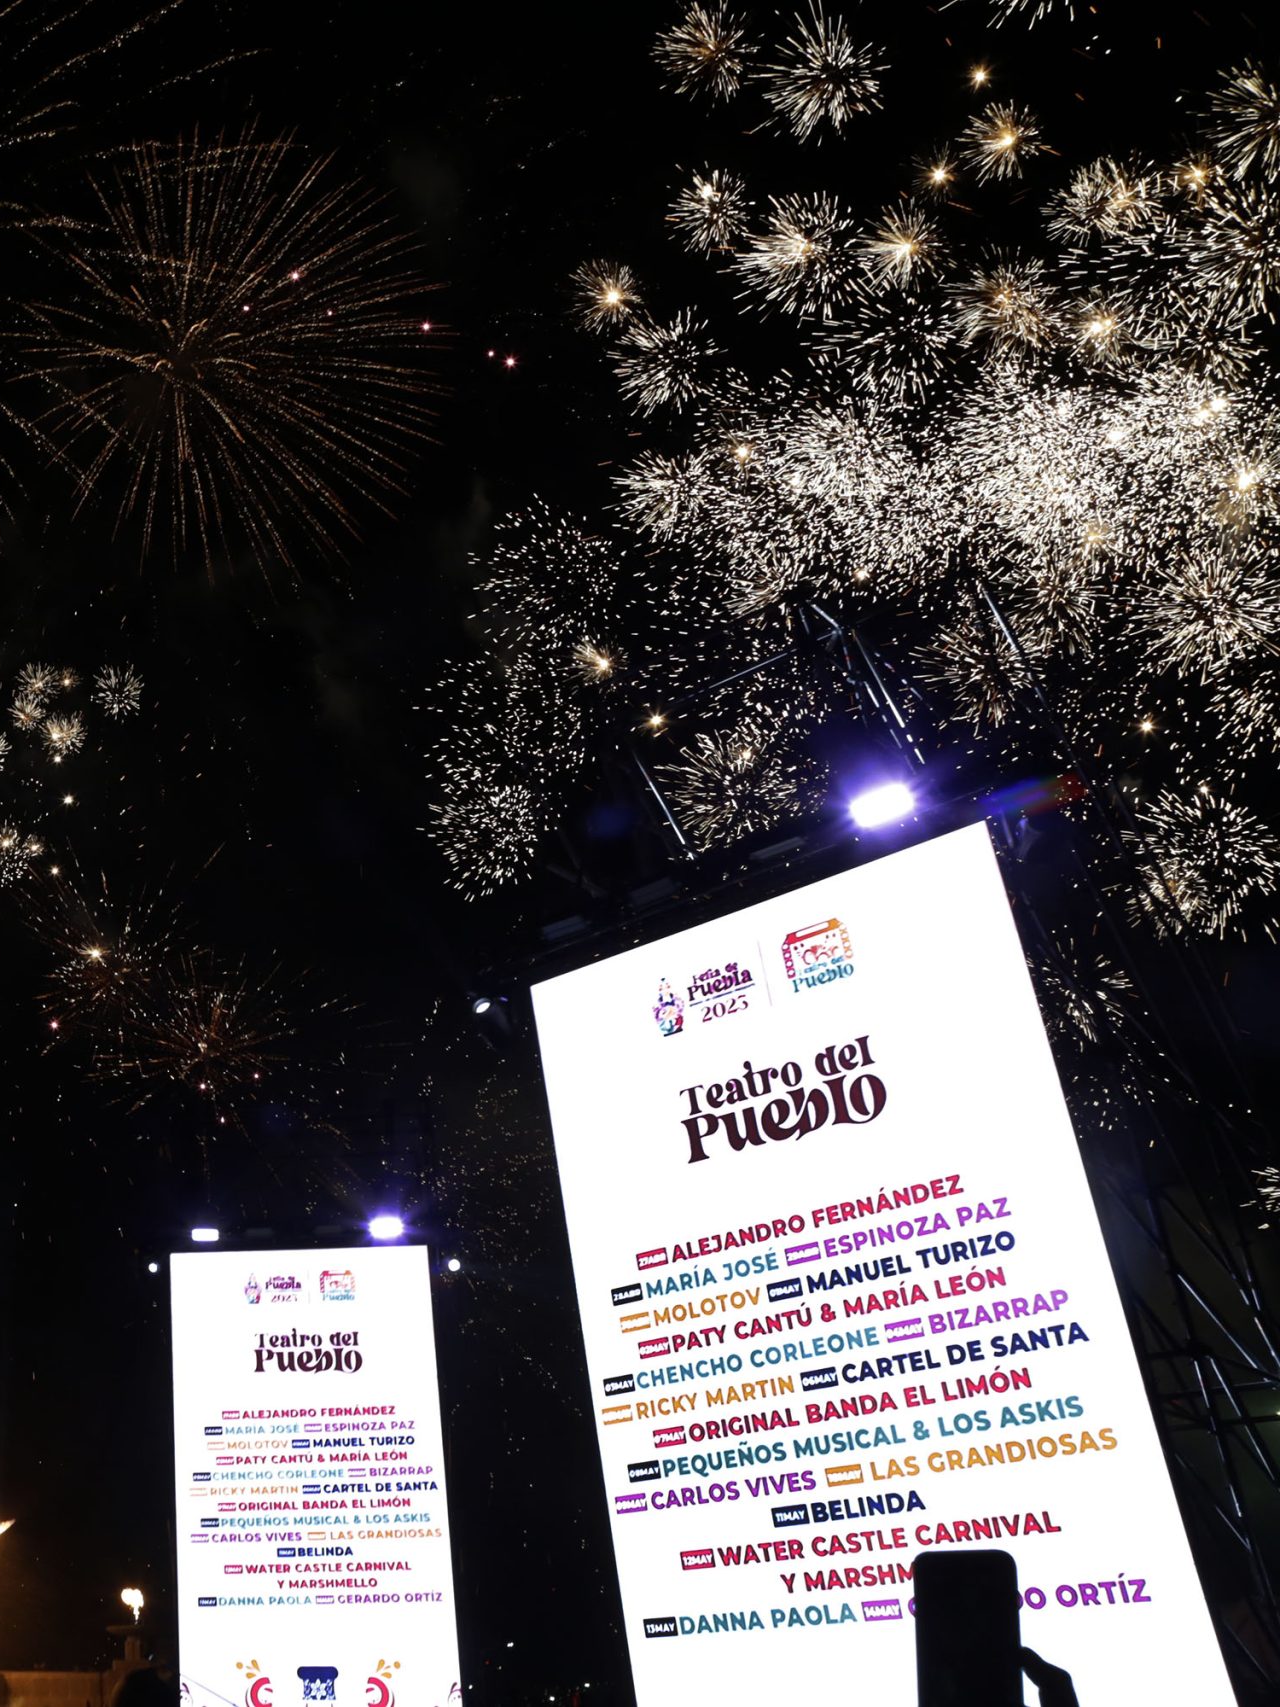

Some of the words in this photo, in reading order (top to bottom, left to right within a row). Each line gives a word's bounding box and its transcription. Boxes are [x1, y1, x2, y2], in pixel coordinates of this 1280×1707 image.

[686, 968, 753, 1001] Puebla
[791, 963, 854, 993] Pueblo
[679, 1060, 802, 1116] Teatro
[814, 1034, 875, 1076] del
[680, 1073, 887, 1164] Pueblo
[671, 1214, 805, 1263] ALEJANDRO
[811, 1173, 964, 1228] FERNÁNDEZ
[645, 1264, 717, 1298] MARÍA
[722, 1246, 779, 1281] JOSÉ
[823, 1212, 951, 1258] ESPINOZA
[955, 1196, 1011, 1227] PAZ
[652, 1286, 760, 1326] MOLOTOV
[805, 1254, 912, 1293] MANUEL
[914, 1230, 1015, 1268] TURIZO
[671, 1324, 726, 1353] PATY
[733, 1301, 812, 1339] CANTÚ
[820, 1302, 836, 1322] &
[842, 1280, 929, 1318] MARÍA
[933, 1265, 1006, 1299] LEÓN
[255, 1328, 322, 1349] Teatro
[329, 1330, 360, 1347] del
[636, 1353, 742, 1389] CHENCHO
[749, 1326, 880, 1368] CORLEONE
[927, 1289, 1068, 1334] BIZARRAP
[254, 1346, 363, 1375] Pueblo
[635, 1391, 697, 1419] RICKY
[705, 1375, 794, 1407] MARTIN
[841, 1348, 941, 1383] CARTEL
[945, 1339, 985, 1365] DE
[989, 1321, 1090, 1357] SANTA
[241, 1407, 316, 1420] ALEJANDRO
[320, 1403, 395, 1417] FERNÁNDEZ
[688, 1407, 800, 1442] ORIGINAL
[804, 1391, 898, 1424] BANDA
[902, 1384, 936, 1408] EL
[940, 1364, 1032, 1401] LIMÓN
[323, 1420, 386, 1432] ESPINOZA
[389, 1419, 414, 1430] PAZ
[661, 1440, 787, 1478] PEQUEÑOS
[792, 1424, 906, 1458] MUSICAL
[912, 1419, 930, 1440] &
[937, 1409, 991, 1437] LOS
[999, 1395, 1083, 1428] ASKIS
[227, 1439, 288, 1451] MOLOTOV
[312, 1436, 365, 1448] MANUEL
[367, 1434, 414, 1446] TURIZO
[235, 1455, 267, 1466] PATY
[270, 1450, 312, 1465] CANTÚ
[316, 1453, 325, 1463] &
[328, 1448, 371, 1462] MARÍA
[373, 1448, 407, 1461] LEÓN
[212, 1470, 273, 1482] CHENCHO
[276, 1468, 344, 1480] CORLEONE
[368, 1464, 432, 1476] BIZARRAP
[650, 1475, 740, 1510] CARLOS
[743, 1469, 816, 1497] VIVES
[869, 1455, 920, 1481] LAS
[927, 1427, 1117, 1472] GRANDIOSAS
[210, 1486, 246, 1497] RICKY
[250, 1485, 298, 1496] MARTIN
[322, 1482, 371, 1494] CARTEL
[374, 1481, 391, 1492] DE
[394, 1480, 438, 1491] SANTA
[237, 1500, 298, 1512] ORIGINAL
[301, 1499, 348, 1510] BANDA
[350, 1498, 366, 1509] EL
[369, 1494, 410, 1508] LIMÓN
[292, 1514, 349, 1526] MUSICAL
[352, 1514, 360, 1524] &
[364, 1513, 389, 1524] LOS
[392, 1512, 430, 1523] ASKIS
[809, 1489, 926, 1523] BELINDA
[211, 1529, 262, 1543] CARLOS
[264, 1531, 302, 1542] VIVES
[329, 1530, 353, 1540] LAS
[356, 1527, 441, 1539] GRANDIOSAS
[716, 1538, 805, 1566] WATER
[810, 1527, 908, 1557] CASTLE
[914, 1510, 1062, 1545] CARNIVAL
[296, 1545, 353, 1557] BELINDA
[244, 1563, 291, 1574] WATER
[294, 1562, 342, 1573] CASTLE
[345, 1560, 412, 1572] CARNIVAL
[779, 1572, 795, 1593] Y
[803, 1561, 918, 1592] MARSHM
[218, 1595, 265, 1606] DANNA
[268, 1594, 312, 1605] PAOLA
[336, 1592, 400, 1604] GERARDO
[403, 1589, 443, 1603] ORTÍZ
[276, 1579, 284, 1589] Y
[288, 1577, 378, 1589] MARSHMELLO
[678, 1610, 765, 1635] DANNA
[770, 1602, 857, 1628] PAOLA
[1054, 1572, 1151, 1607] ORTÍZ
